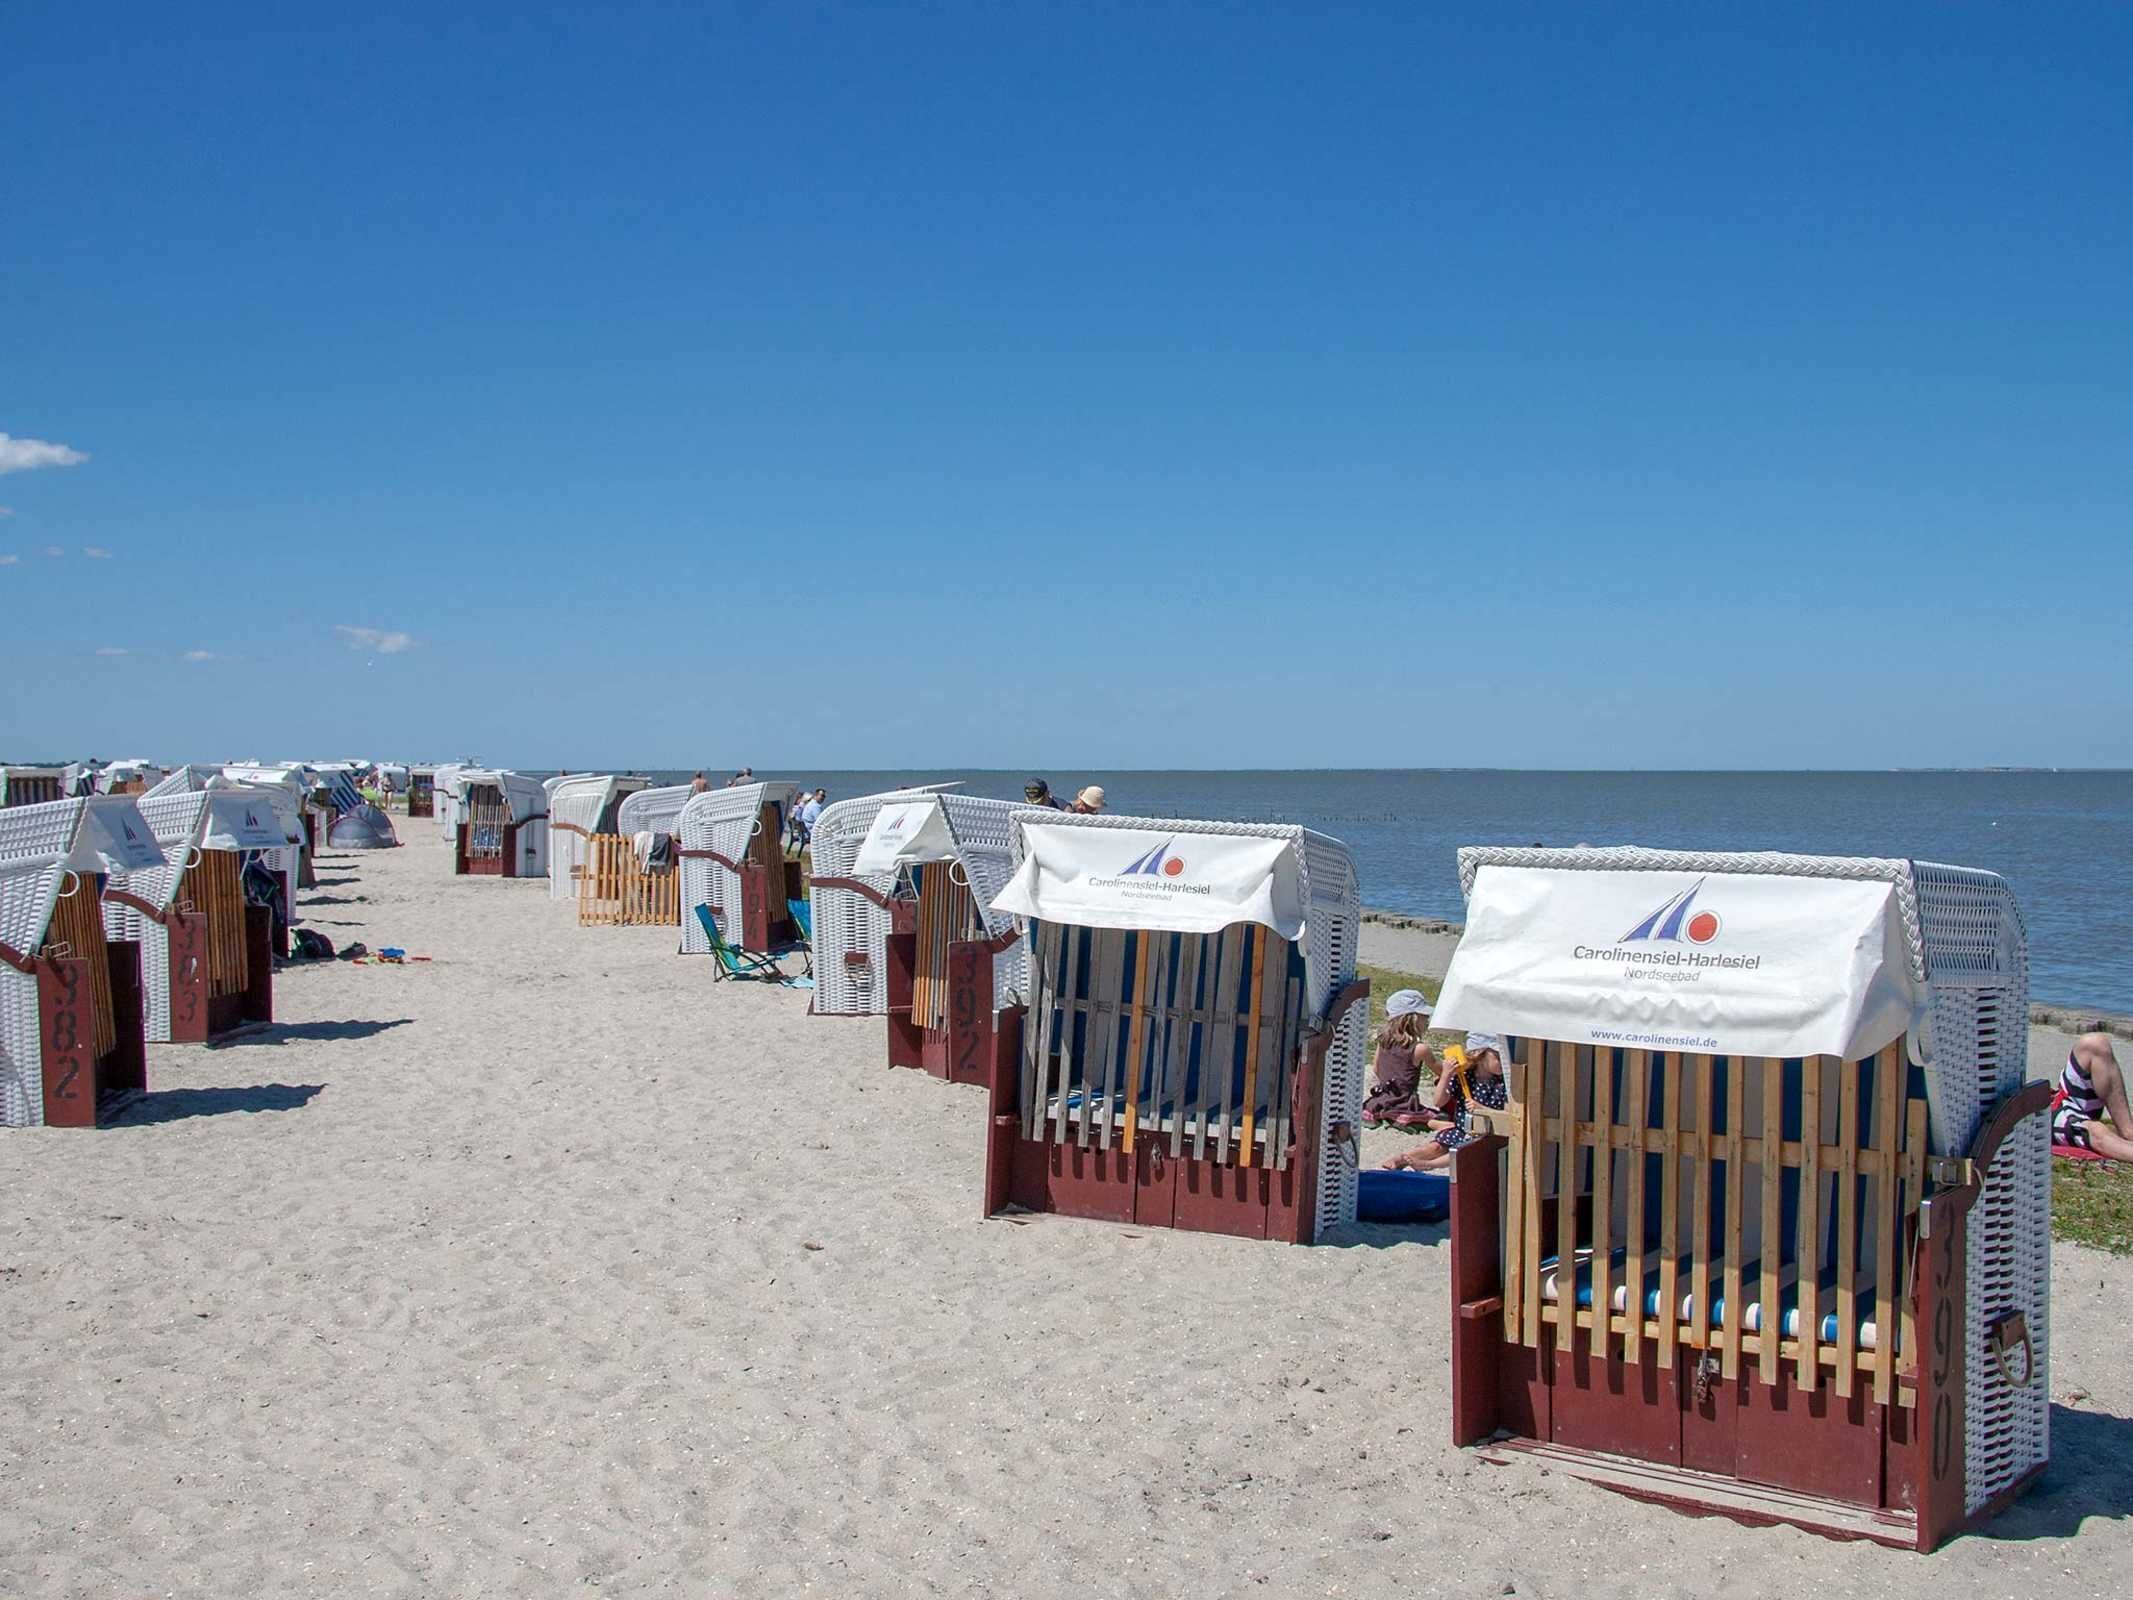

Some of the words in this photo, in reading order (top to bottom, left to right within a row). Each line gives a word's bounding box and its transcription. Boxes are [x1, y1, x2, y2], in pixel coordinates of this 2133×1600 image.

[1088, 877, 1210, 895] Carolinensiel-Harlesiel
[1573, 945, 1760, 970] Carolinensiel-Harlesiel
[1624, 967, 1702, 982] Nordseebad
[955, 945, 978, 1070] 392
[53, 963, 79, 1098] 382
[1591, 1030, 1718, 1048] www.carolinensiel.de
[1933, 1200, 1955, 1481] 390
